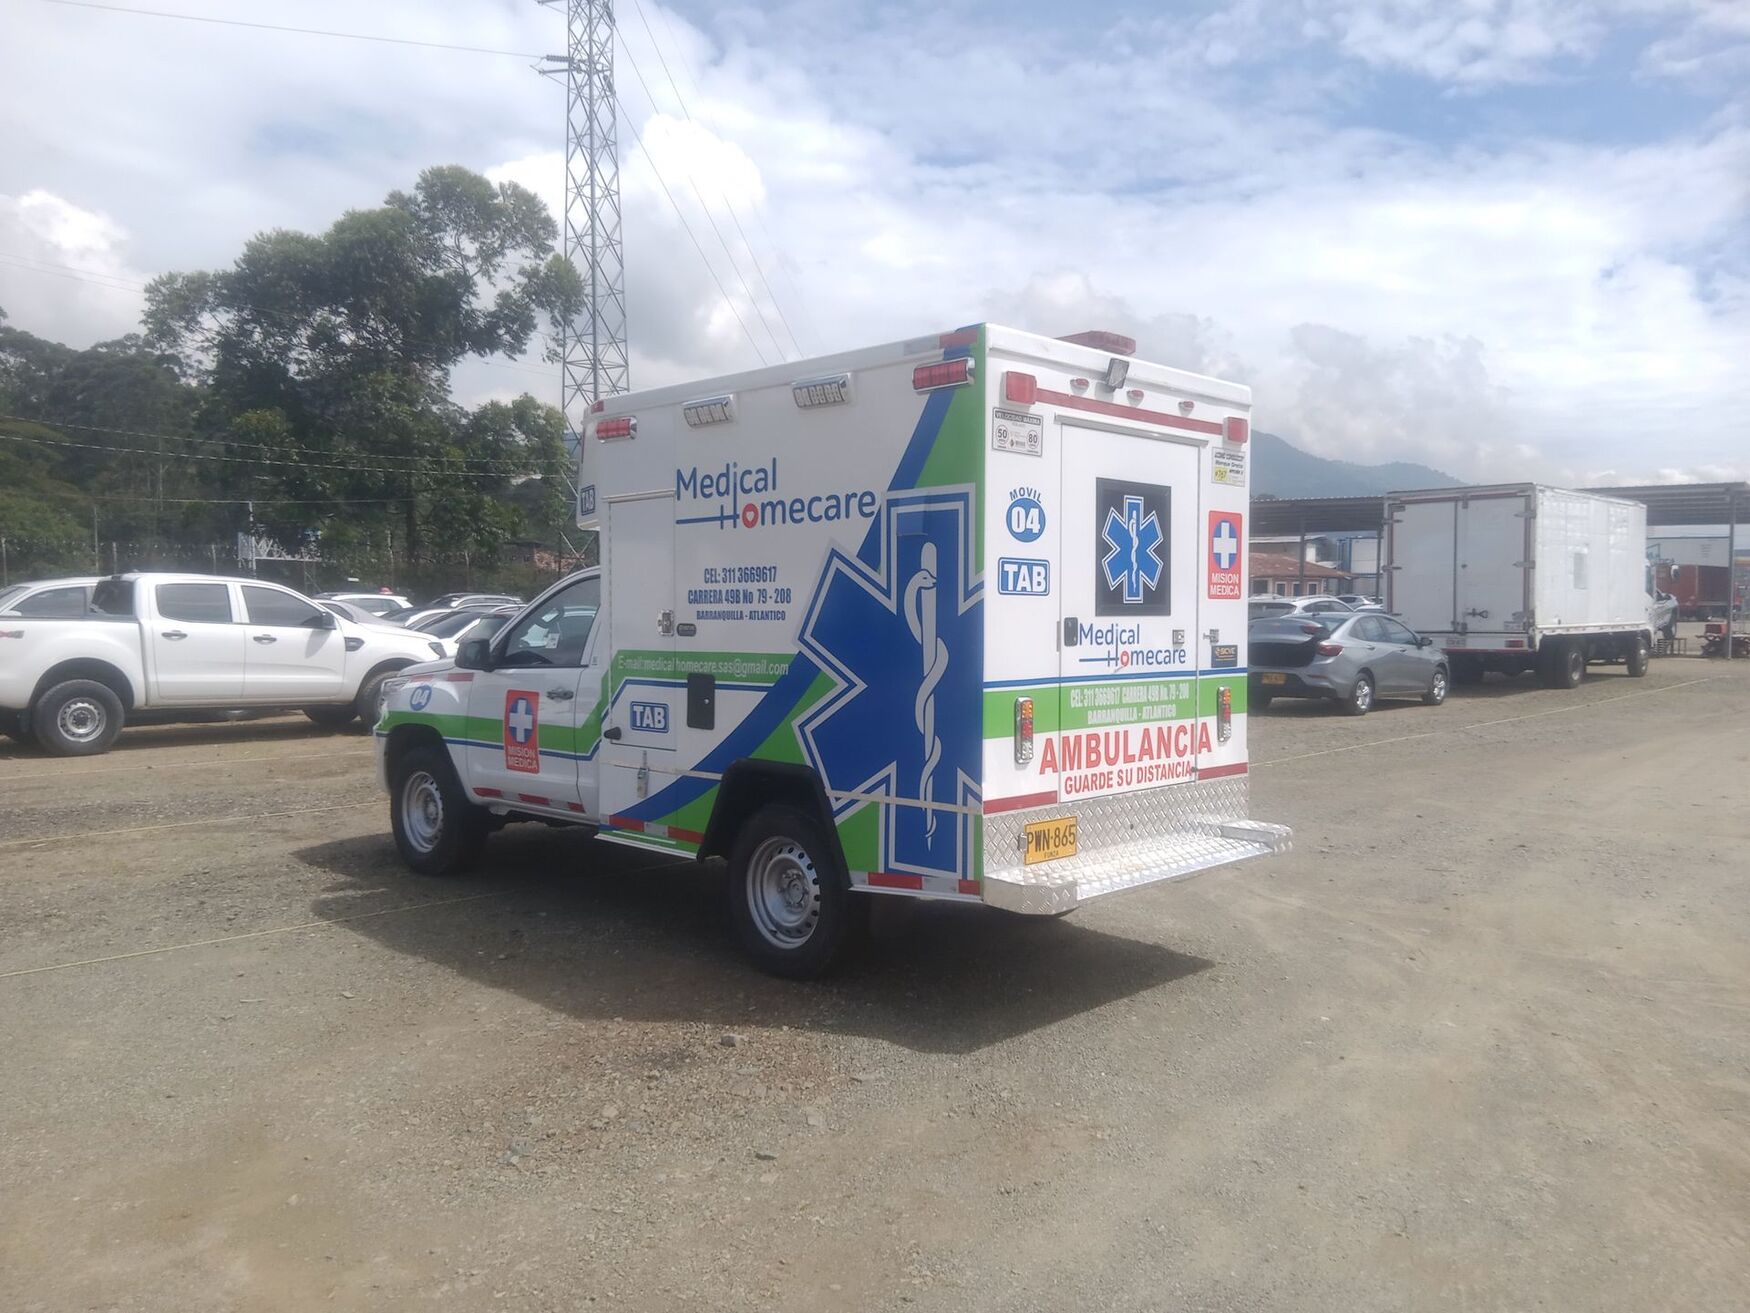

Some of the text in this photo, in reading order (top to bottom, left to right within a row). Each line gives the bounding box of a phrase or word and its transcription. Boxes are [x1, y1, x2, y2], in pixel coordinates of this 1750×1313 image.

[997, 428, 1008, 439] 50
[1028, 433, 1038, 444] 80
[675, 457, 777, 501] Medical
[718, 490, 877, 530] Homecare
[1011, 506, 1041, 534] 04
[704, 566, 777, 584] CEL: 311 3669617
[1003, 563, 1046, 592] TAB
[1211, 572, 1240, 584] MISION
[688, 589, 724, 604] CARRERA
[757, 588, 768, 604] 79
[774, 588, 792, 604] 208
[1210, 584, 1240, 596] MEDICA
[696, 610, 744, 621] BARRANQUILLA
[749, 610, 786, 620] ATLANTICO
[1079, 623, 1140, 646] Medical
[1106, 649, 1186, 668] Homecare
[412, 689, 430, 706] 04
[632, 705, 665, 729] TAB
[508, 746, 536, 758] MISION
[1039, 722, 1213, 775] AMBULANCIA
[507, 756, 538, 770] MEDICA
[1064, 761, 1192, 795] GUARDE SU DISTANCIA
